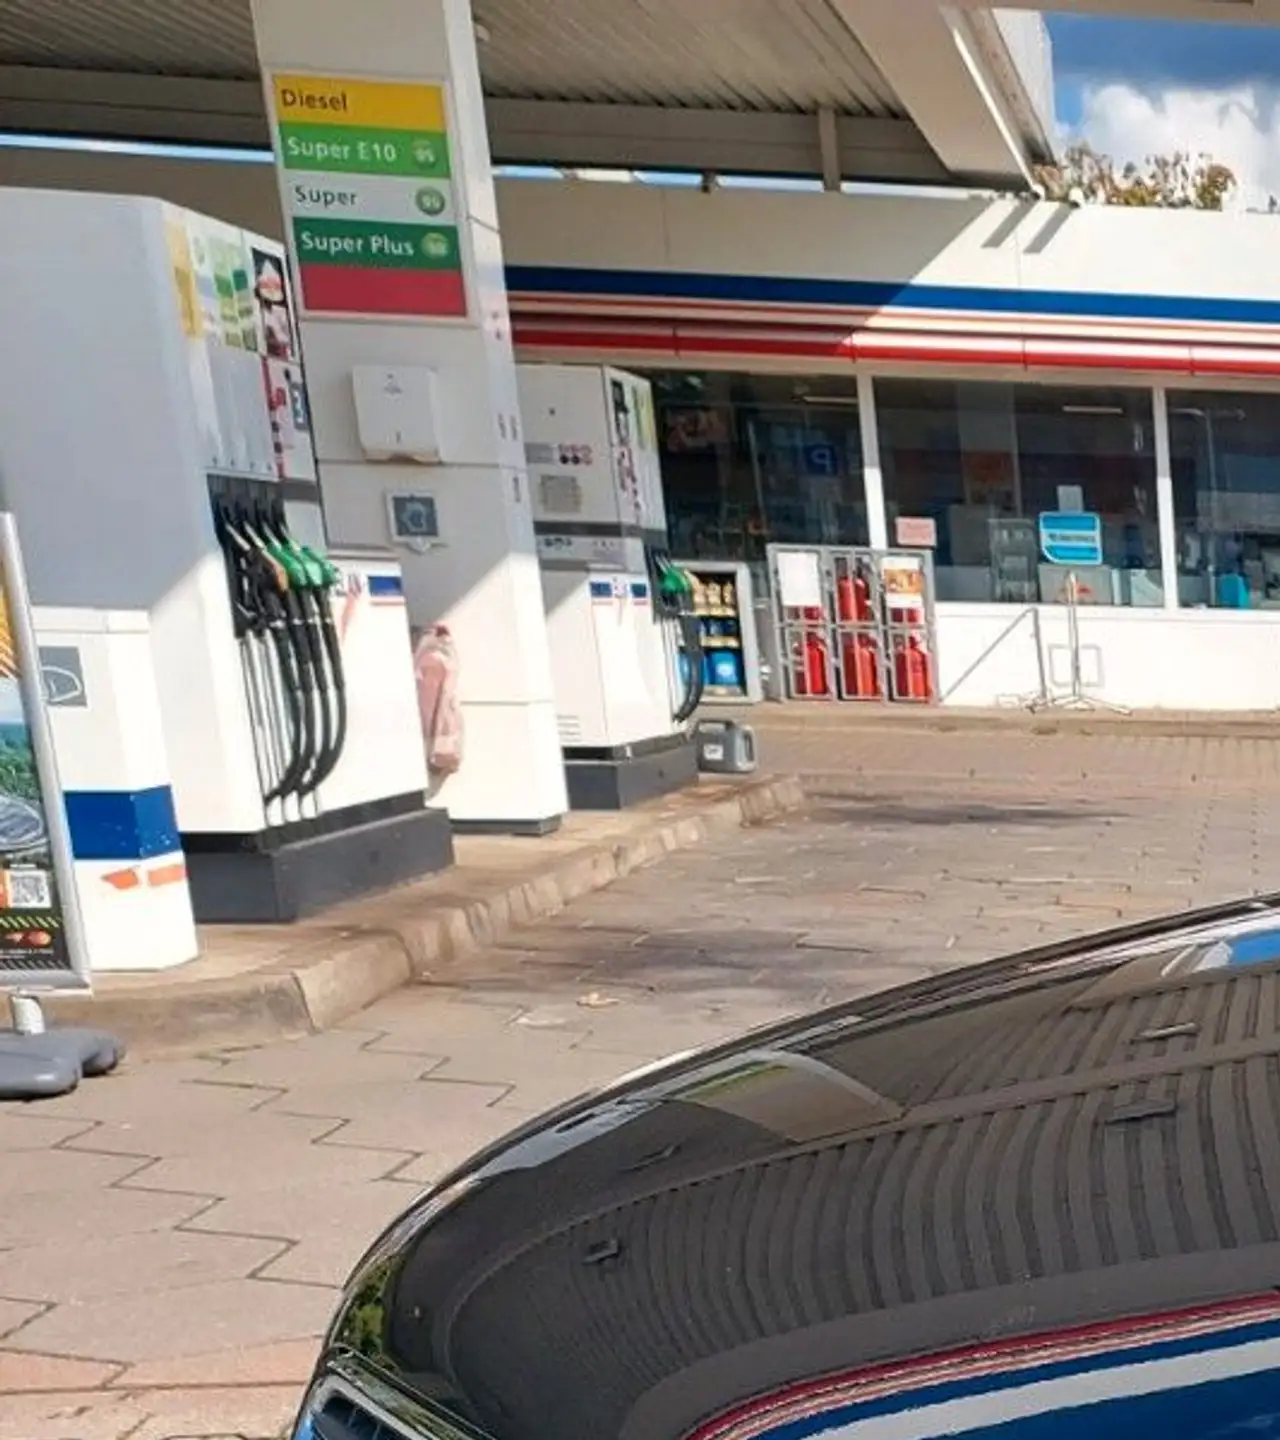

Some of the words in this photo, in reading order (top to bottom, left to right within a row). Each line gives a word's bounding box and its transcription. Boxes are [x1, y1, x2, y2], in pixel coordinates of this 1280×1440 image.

[281, 88, 348, 112] Diesel
[287, 136, 350, 161] Super
[358, 141, 397, 162] E10
[295, 184, 358, 207] Super
[301, 231, 364, 255] Super
[370, 235, 415, 256] Plus
